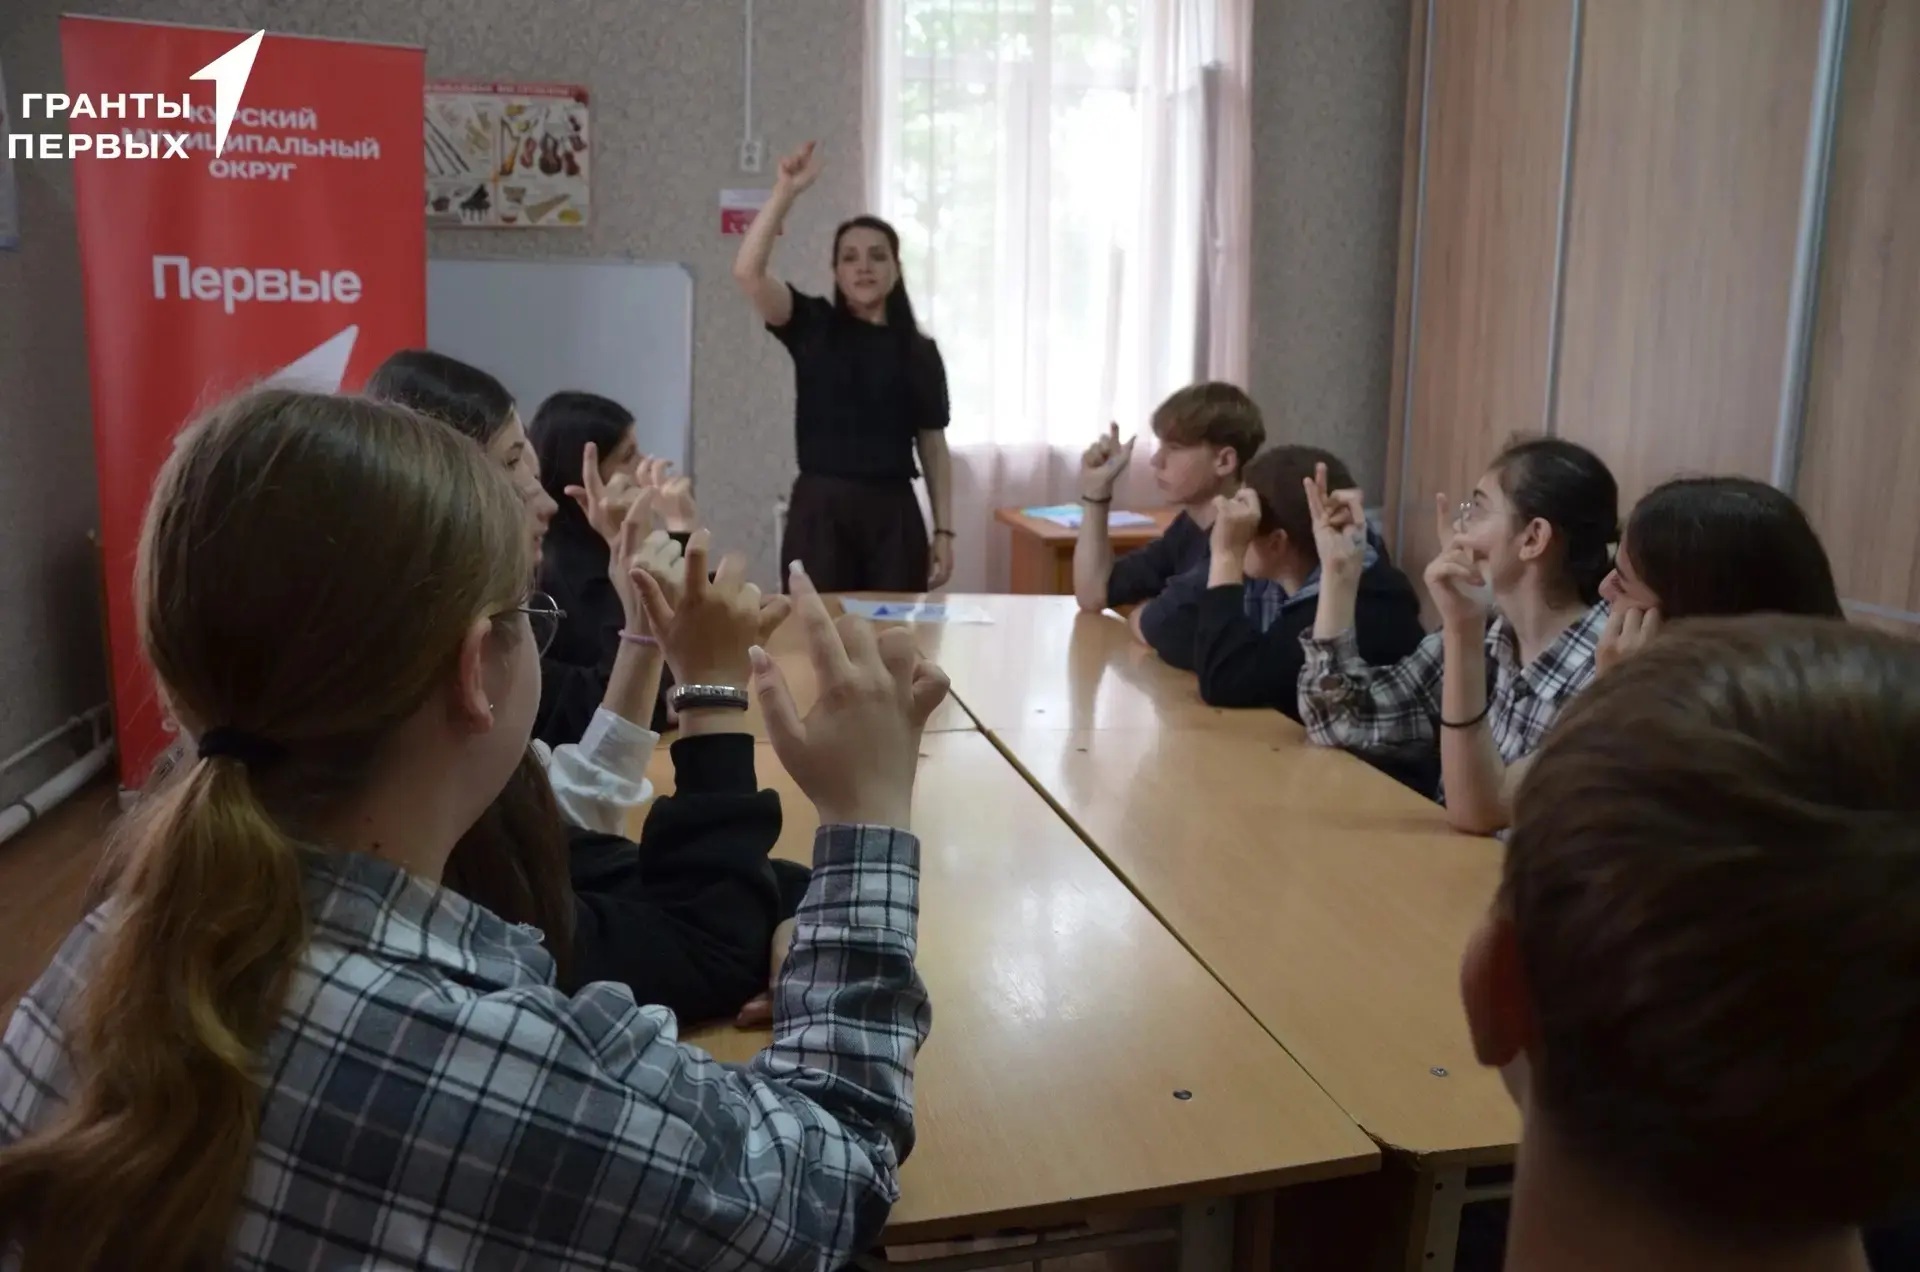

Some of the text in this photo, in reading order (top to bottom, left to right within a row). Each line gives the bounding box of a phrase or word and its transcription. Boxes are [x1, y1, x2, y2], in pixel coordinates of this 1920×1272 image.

[188, 104, 318, 130] КУСКИЙ
[208, 158, 297, 181] ОКРУГ
[152, 255, 362, 314] Первые
